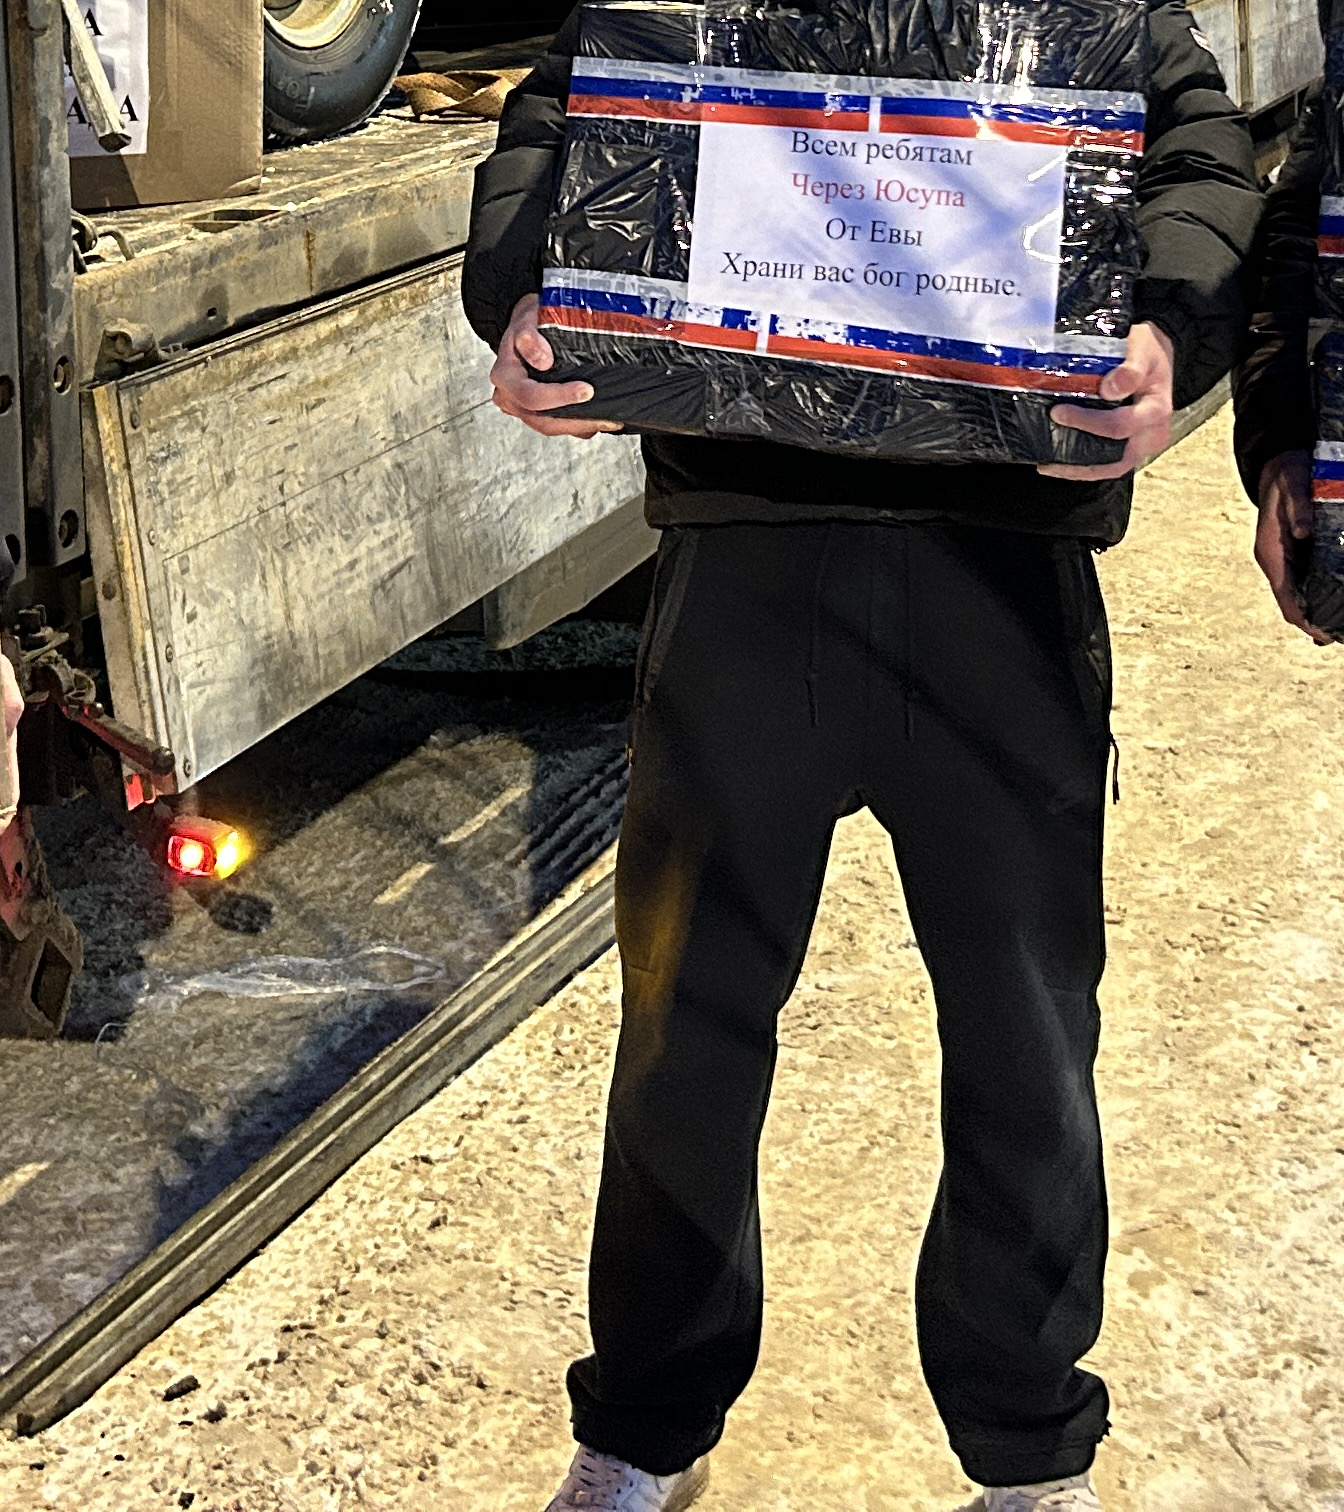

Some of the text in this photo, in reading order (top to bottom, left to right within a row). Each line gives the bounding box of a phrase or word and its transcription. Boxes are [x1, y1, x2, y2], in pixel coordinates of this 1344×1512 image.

[791, 130, 974, 166] Всем ребятам
[791, 172, 966, 210] Через Юсупа
[825, 217, 923, 247] От Евы
[720, 251, 1022, 297] Храни вас бог родные.
